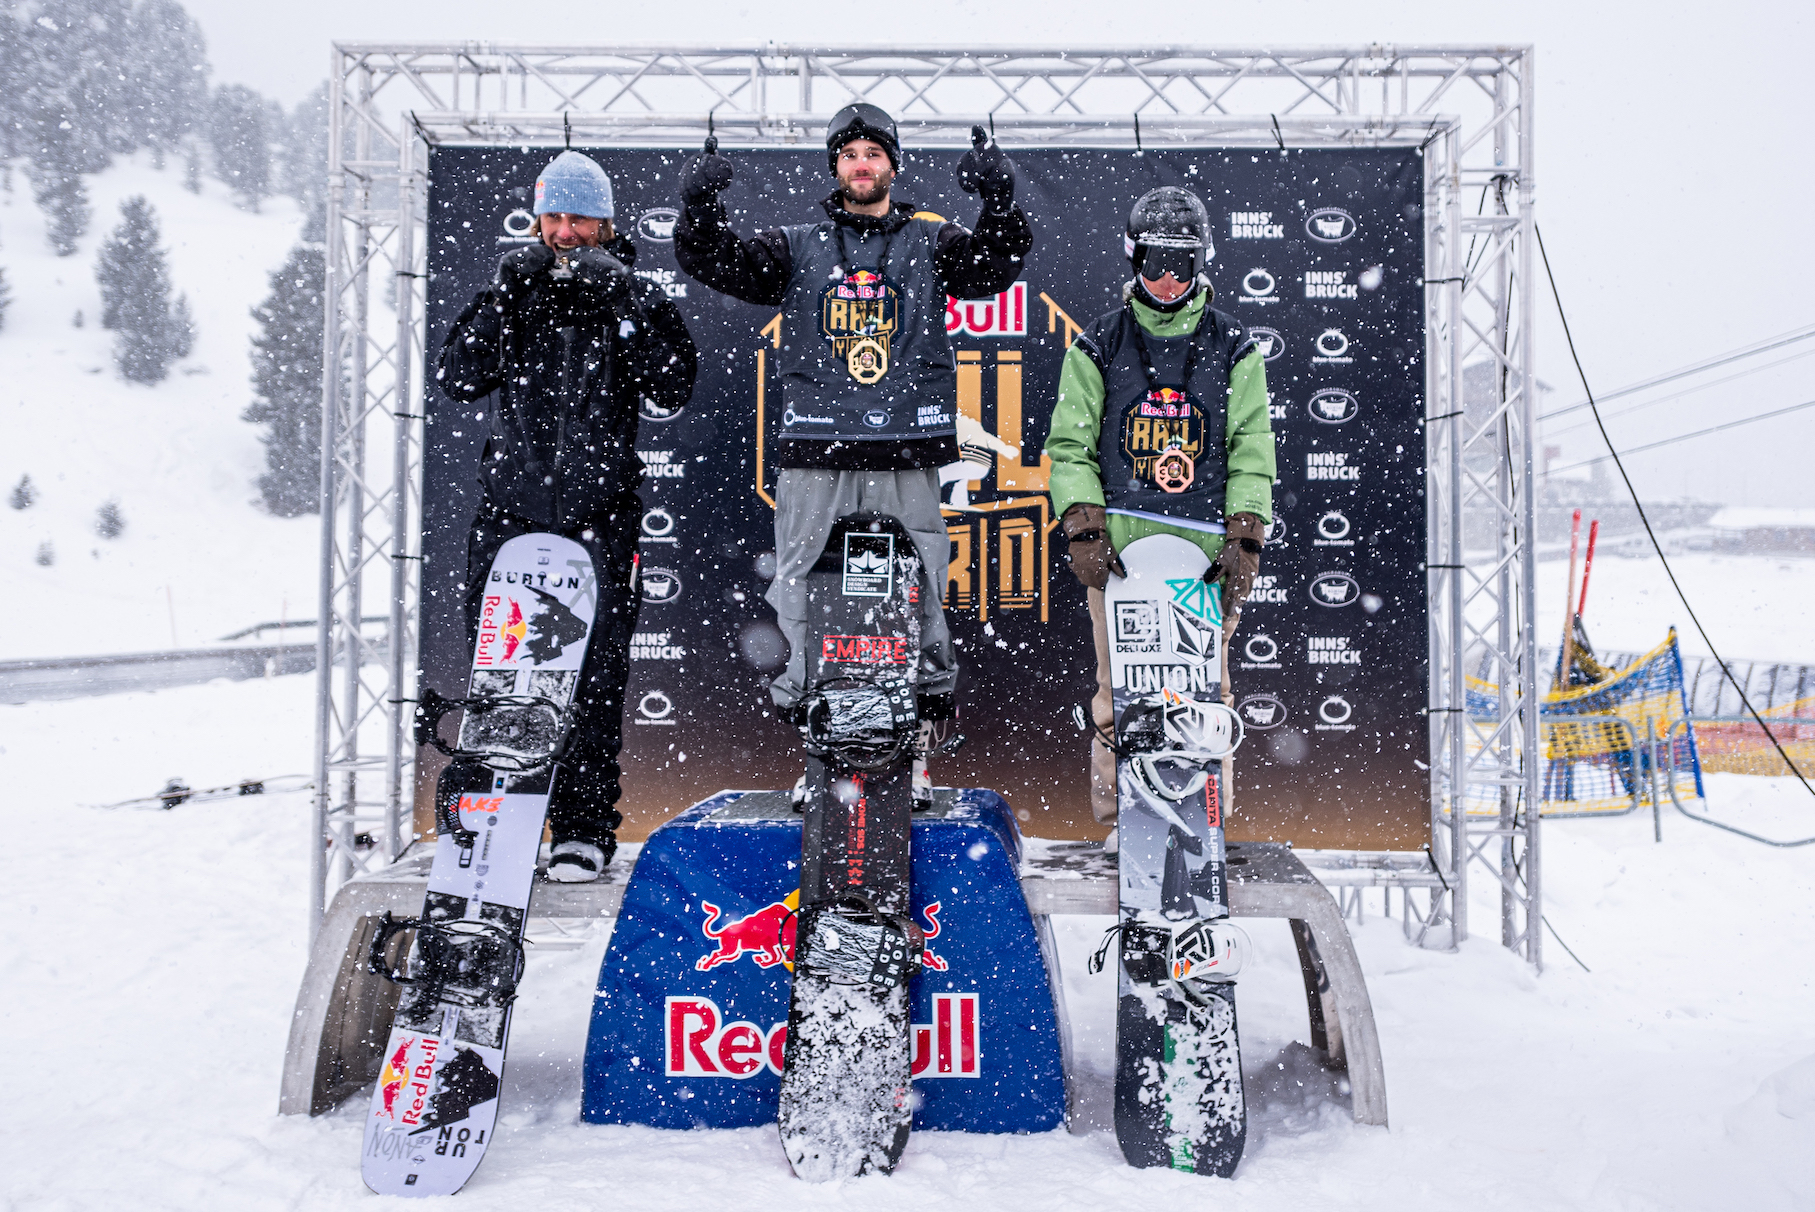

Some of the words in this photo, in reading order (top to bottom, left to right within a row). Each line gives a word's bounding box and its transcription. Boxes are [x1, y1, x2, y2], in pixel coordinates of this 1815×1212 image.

[1232, 212, 1273, 224] INNS'
[1232, 225, 1284, 238] BRUCK
[1306, 272, 1347, 284] INNS'
[1306, 285, 1358, 297] BRUCK
[917, 405, 942, 416] INNS'
[918, 413, 950, 426] BRUCK
[637, 451, 673, 463] NNS'
[1308, 453, 1349, 466] INNS'
[646, 464, 684, 477] RUCK
[1308, 467, 1360, 479] BRUCK
[491, 570, 579, 589] BURTON
[1253, 576, 1277, 588] NS'
[482, 596, 501, 630] Red
[477, 633, 496, 665] Bull
[822, 639, 907, 660] EMPIRE
[1116, 644, 1162, 653] DELUXE
[1309, 638, 1350, 650] INNS'
[630, 647, 682, 659] BRUCK
[1309, 651, 1361, 664] BRUCK
[1126, 665, 1207, 692] UNION
[885, 682, 905, 722] SDS
[897, 679, 915, 721] ROME
[858, 798, 866, 827] ROME
[857, 829, 865, 849] SDS
[415, 1038, 440, 1080] Bull
[402, 1082, 429, 1125] Red
